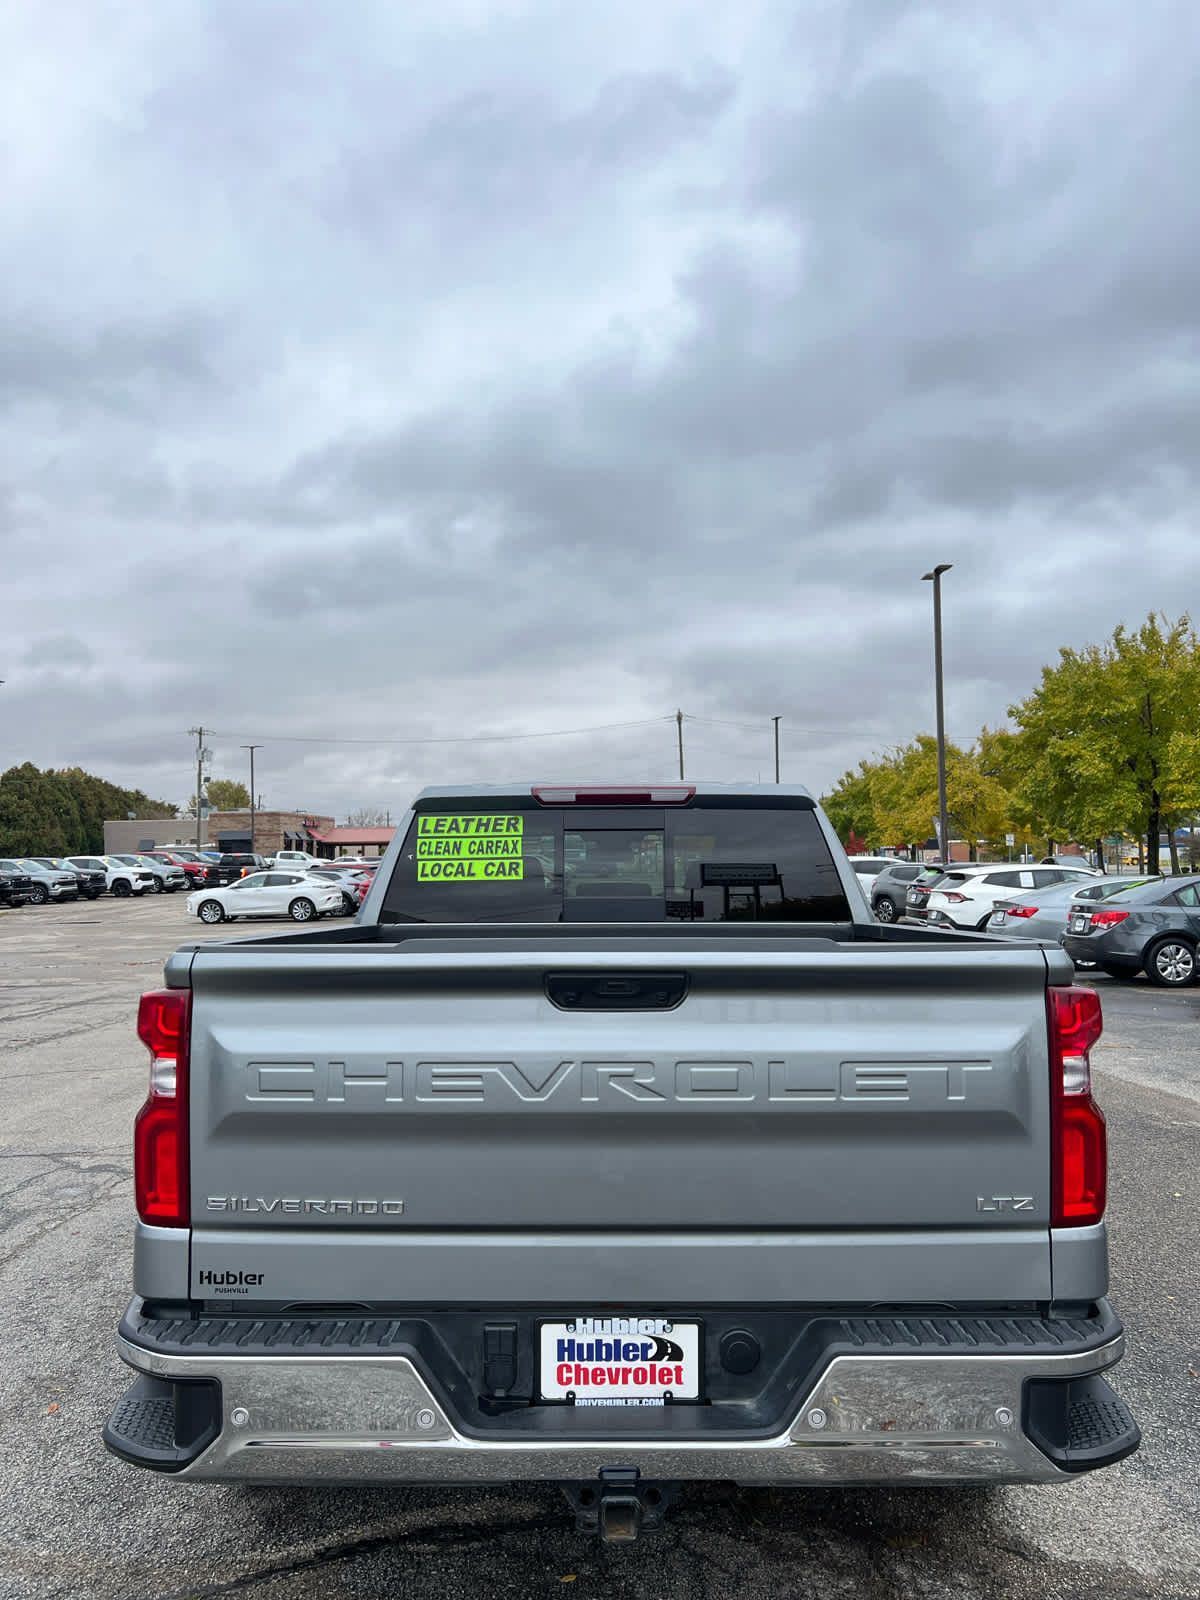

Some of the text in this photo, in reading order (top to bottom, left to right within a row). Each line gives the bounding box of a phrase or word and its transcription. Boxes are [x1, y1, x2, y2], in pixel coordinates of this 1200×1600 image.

[420, 817, 520, 834] LEATHER
[419, 840, 519, 855] CLEAN CARFAX
[420, 861, 520, 877] LOCAL CAR
[246, 1061, 993, 1101] CHEVROLET
[206, 1197, 404, 1215] SILVERADO
[976, 1196, 1035, 1212] LTZ
[199, 1270, 265, 1285] Hubler
[576, 1318, 668, 1335] Hubler
[556, 1339, 653, 1362] Hubler
[556, 1363, 684, 1386] Chevrolet
[575, 1398, 665, 1407] DRIVEHUBLER.COM
